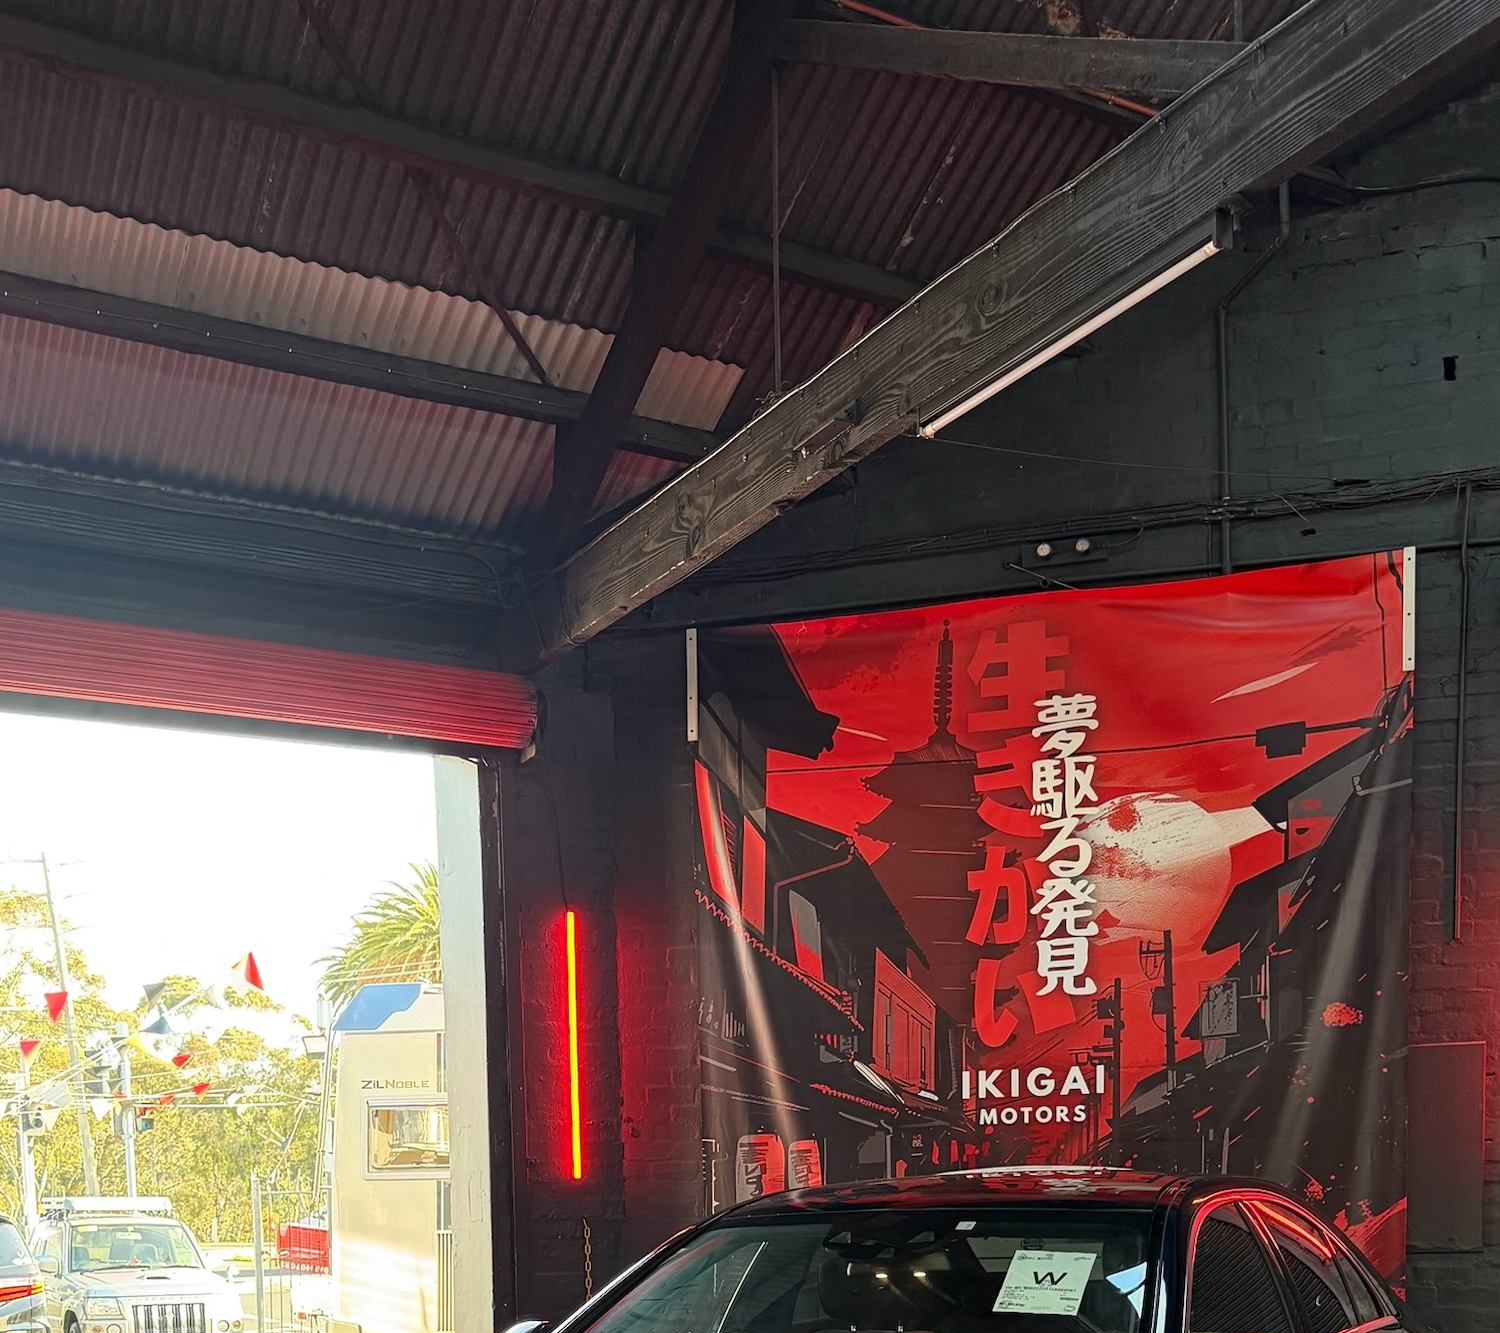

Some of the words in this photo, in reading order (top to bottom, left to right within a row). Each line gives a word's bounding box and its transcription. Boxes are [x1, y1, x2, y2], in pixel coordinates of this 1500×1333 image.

[1031, 694, 1098, 996] 夢駆る発見
[962, 1065, 1104, 1100] IKIGAI
[979, 1104, 1087, 1125] MOTORS
[1033, 1271, 1068, 1286] W
